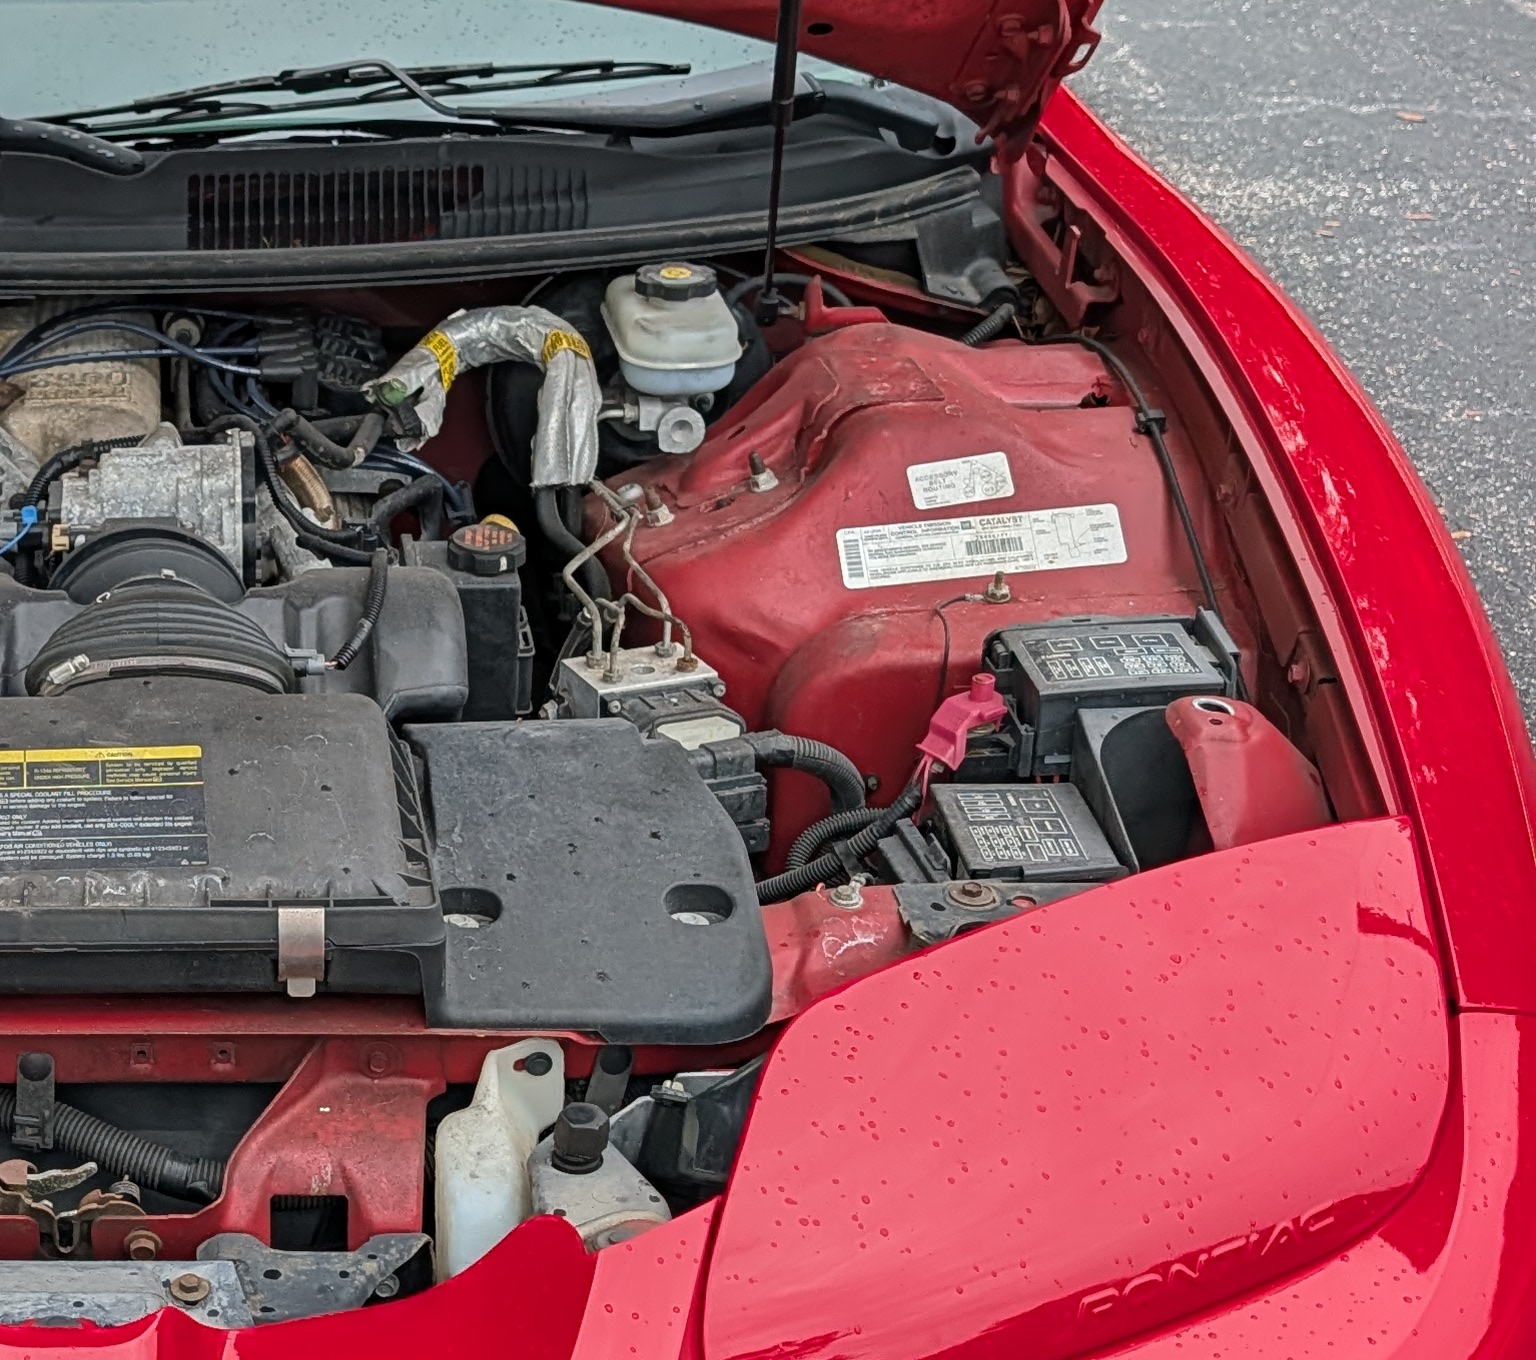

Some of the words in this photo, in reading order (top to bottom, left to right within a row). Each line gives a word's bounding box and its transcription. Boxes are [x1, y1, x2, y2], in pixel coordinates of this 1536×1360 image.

[914, 470, 958, 482] ACCESSORY
[928, 478, 946, 486] BELT
[922, 483, 956, 493] ROUTING
[979, 515, 1023, 527] CATALYST
